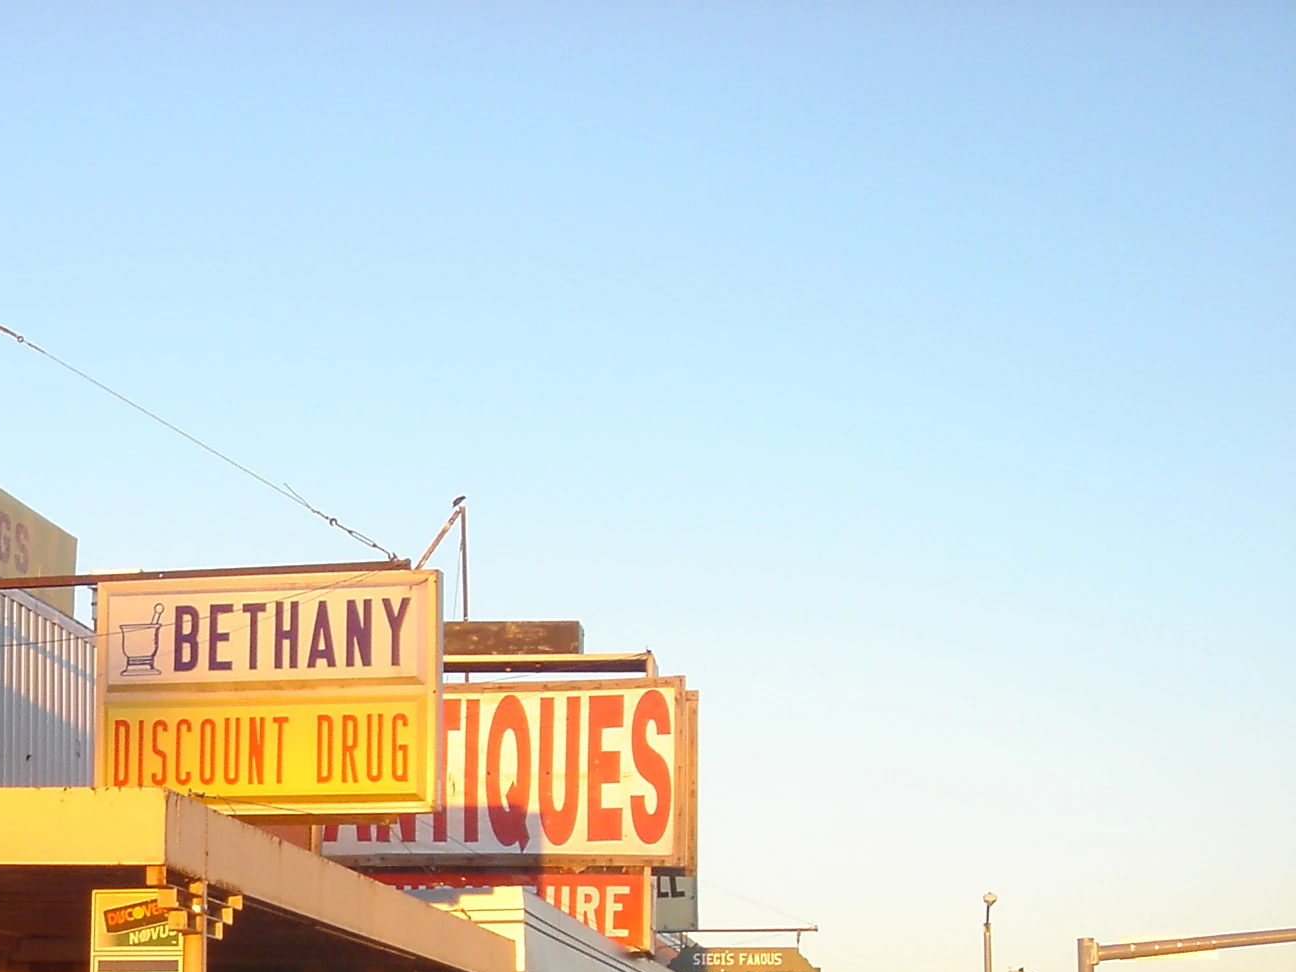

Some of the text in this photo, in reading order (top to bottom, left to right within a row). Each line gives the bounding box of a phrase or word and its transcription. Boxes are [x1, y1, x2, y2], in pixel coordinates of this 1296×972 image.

[172, 597, 412, 674] BETHANY
[113, 712, 409, 787] DISCOUNT DRUG
